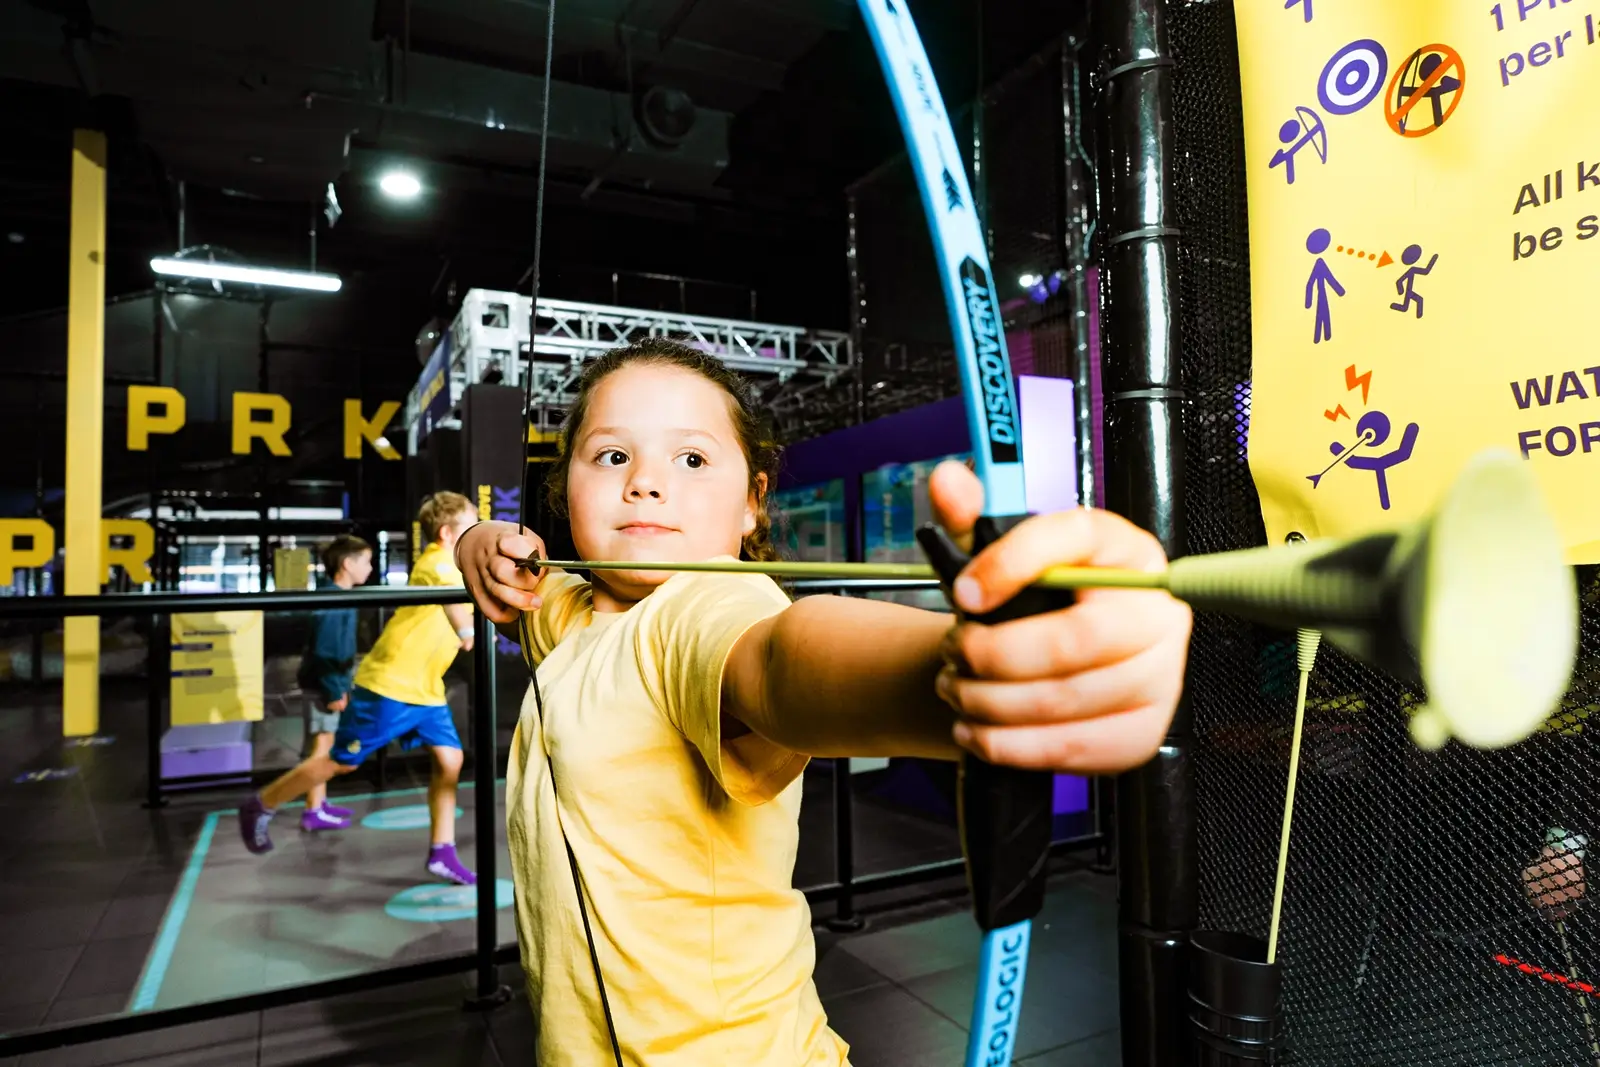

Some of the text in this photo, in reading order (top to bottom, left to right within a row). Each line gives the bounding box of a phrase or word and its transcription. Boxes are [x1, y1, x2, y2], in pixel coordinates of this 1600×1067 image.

[1490, 3, 1504, 31] 1
[1499, 30, 1572, 87] per
[1513, 169, 1562, 215] All
[1513, 226, 1563, 261] be
[963, 276, 1015, 445] DISCOVERY
